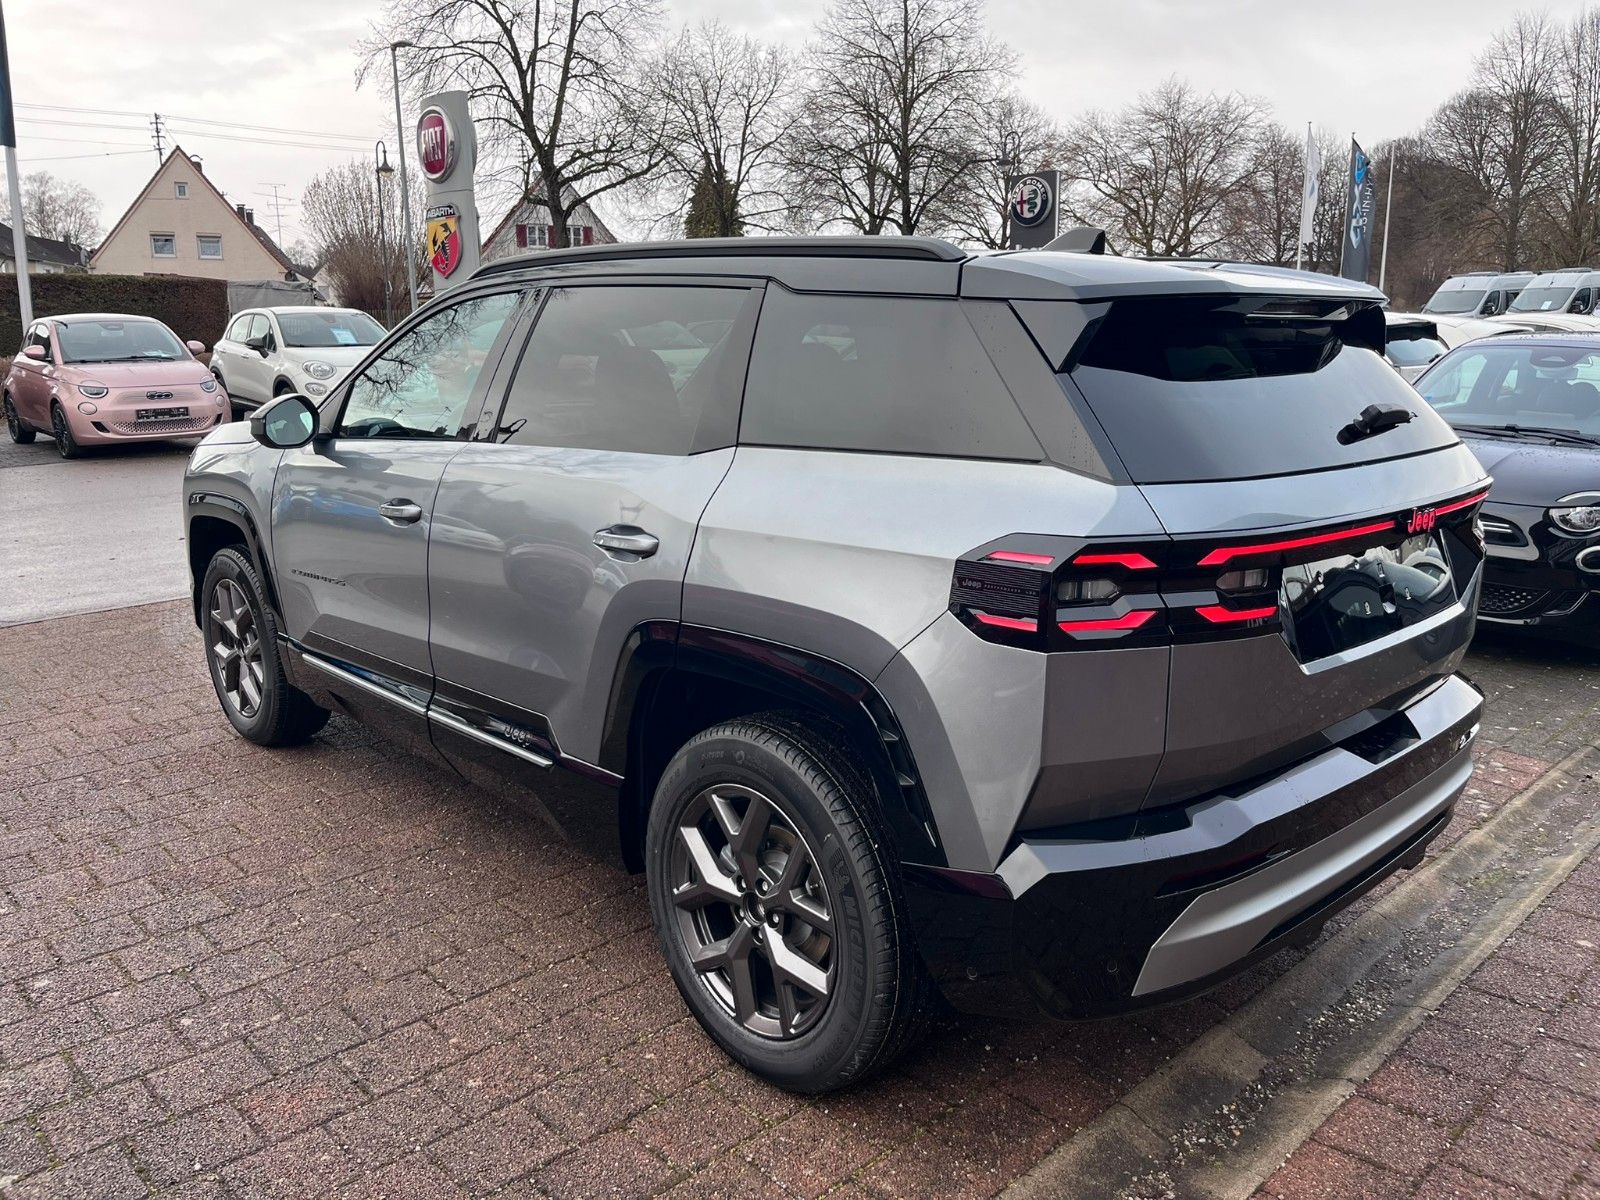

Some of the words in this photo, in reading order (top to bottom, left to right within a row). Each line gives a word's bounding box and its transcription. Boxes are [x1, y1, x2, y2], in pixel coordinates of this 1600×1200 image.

[421, 126, 443, 163] FIAT
[1026, 179, 1047, 200] ROMEO
[427, 207, 454, 219] ABARTH
[1407, 507, 1436, 533] Jeep
[962, 579, 982, 589] Jeep
[504, 724, 531, 748] Jeep
